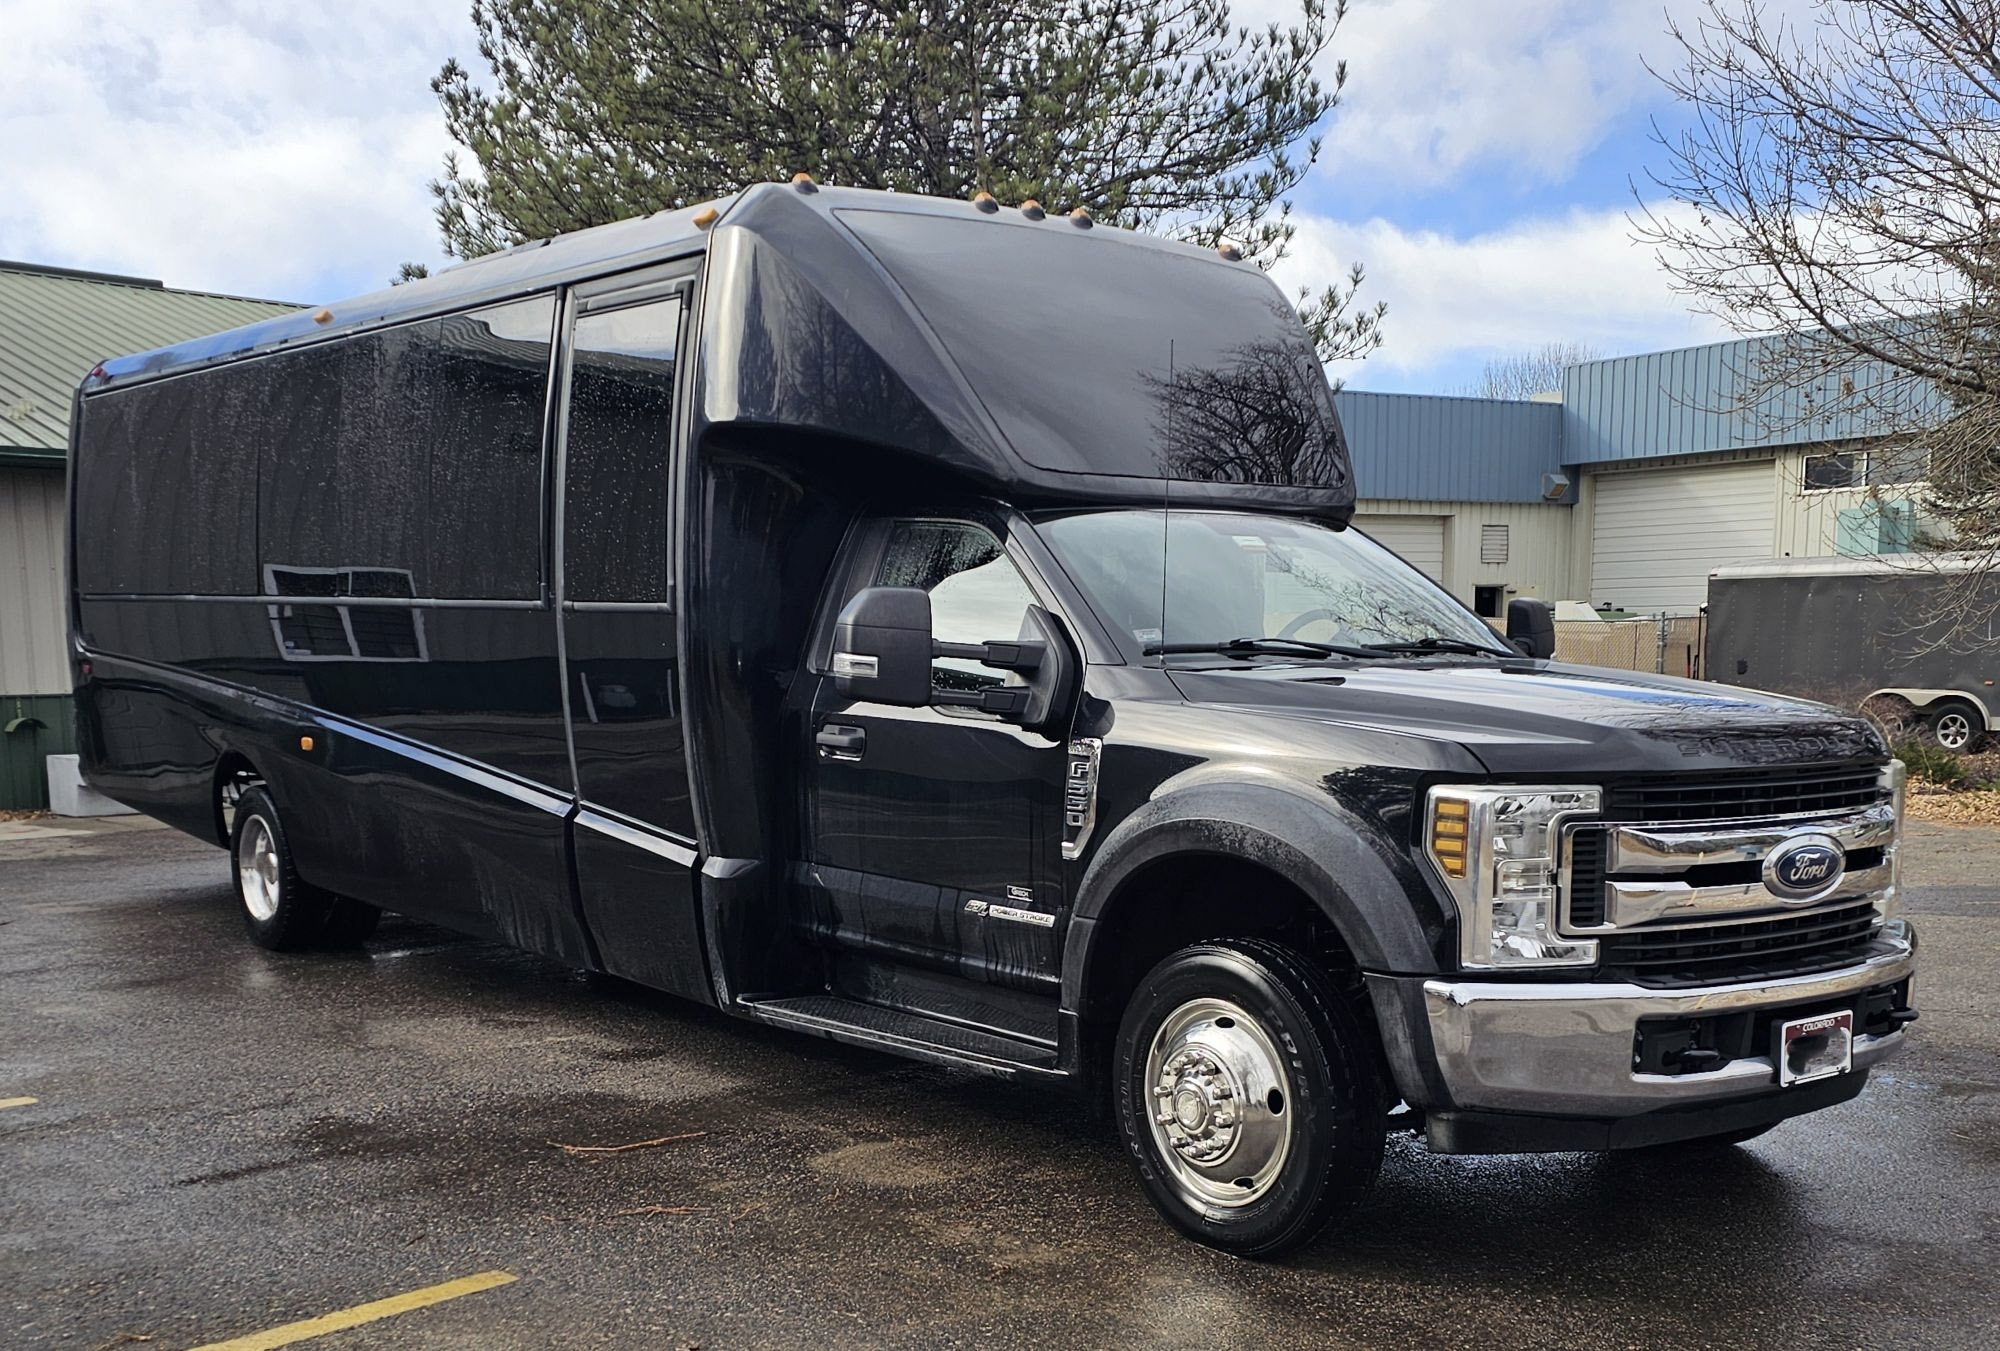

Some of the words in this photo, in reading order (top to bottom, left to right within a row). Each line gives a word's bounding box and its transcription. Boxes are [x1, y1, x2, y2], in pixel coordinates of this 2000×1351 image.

[1790, 852, 1830, 881] Ford
[990, 905, 1018, 917] POWER
[1019, 911, 1052, 924] STROKE
[1802, 1018, 1836, 1032] COLORADO
